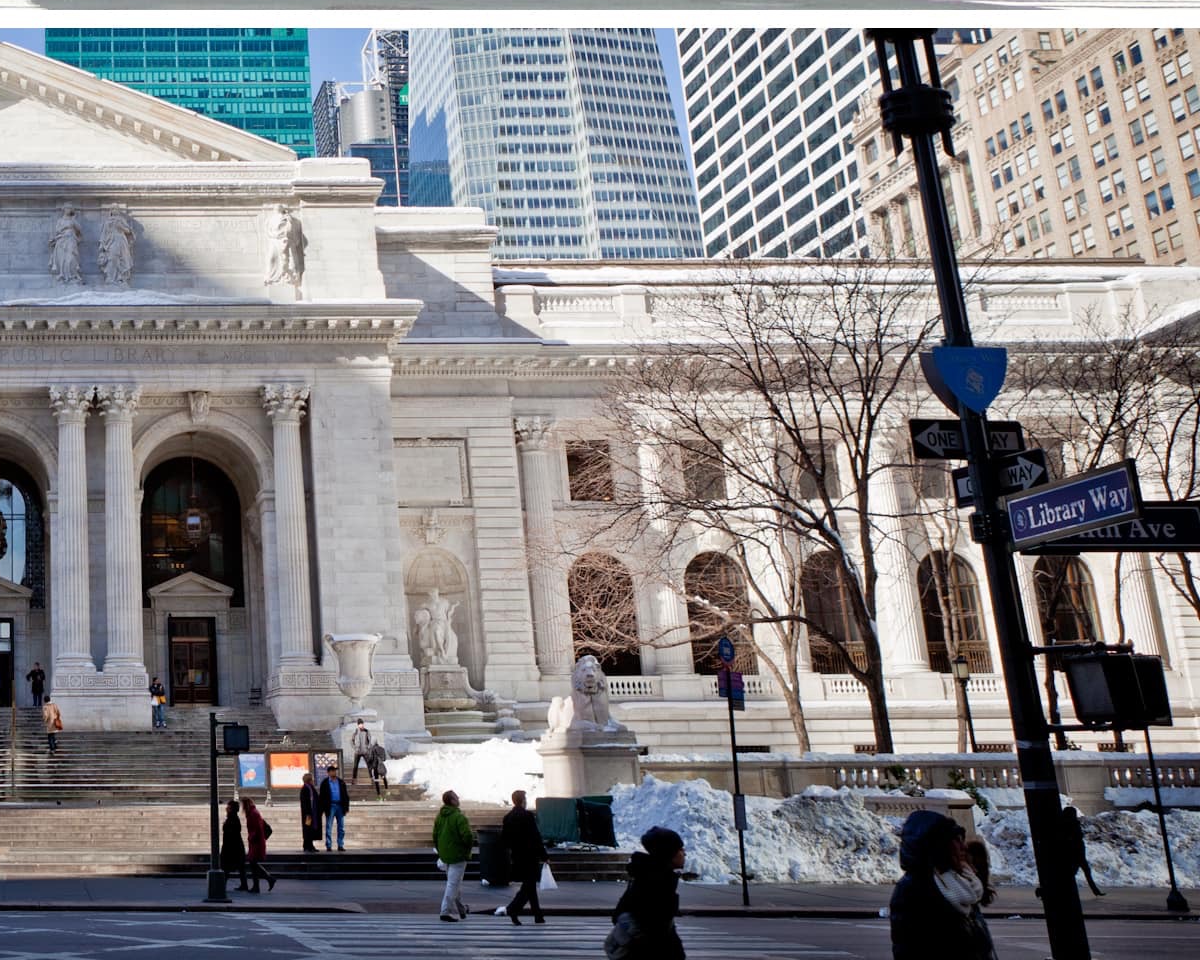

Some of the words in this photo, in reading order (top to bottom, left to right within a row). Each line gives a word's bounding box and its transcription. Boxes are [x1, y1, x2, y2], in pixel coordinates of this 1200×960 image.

[0, 349, 74, 363] PUBLIC
[92, 348, 180, 363] LIBRARY
[927, 431, 957, 448] ONE
[990, 432, 1009, 450] AY
[1007, 463, 1033, 484] WAY
[1027, 497, 1086, 529] Library
[1088, 486, 1129, 514] Way
[1129, 519, 1177, 538] Ave
